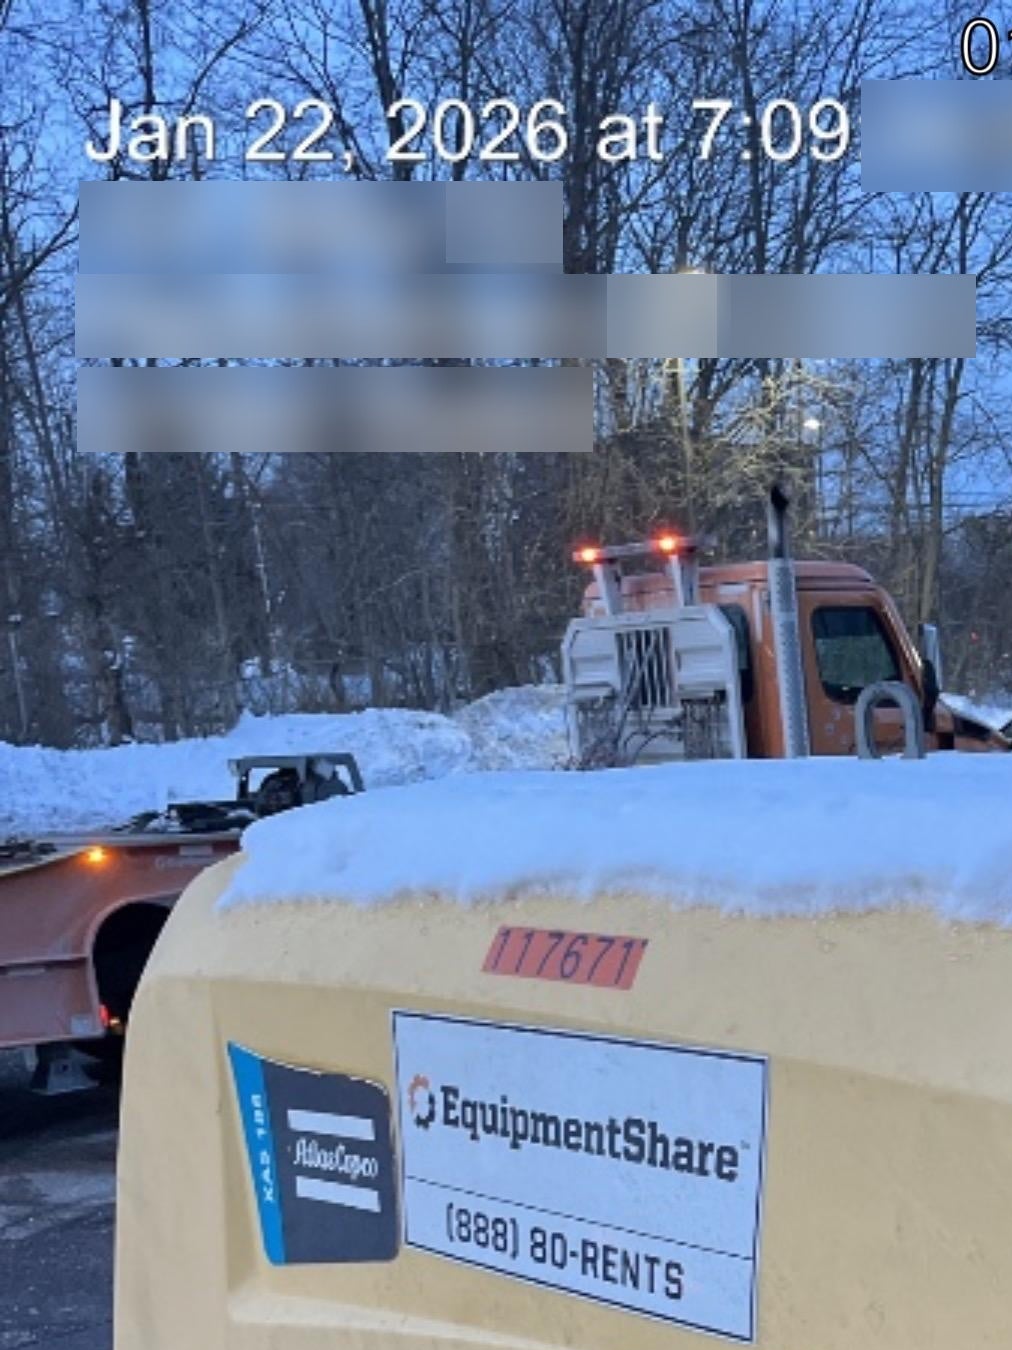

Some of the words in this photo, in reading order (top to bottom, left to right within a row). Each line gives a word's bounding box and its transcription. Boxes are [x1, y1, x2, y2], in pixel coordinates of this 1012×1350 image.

[491, 929, 636, 985] 117671
[440, 1085, 740, 1183] EquipmentShare
[446, 1202, 521, 1261] (888)
[529, 1226, 685, 1300] 80-RENTS
